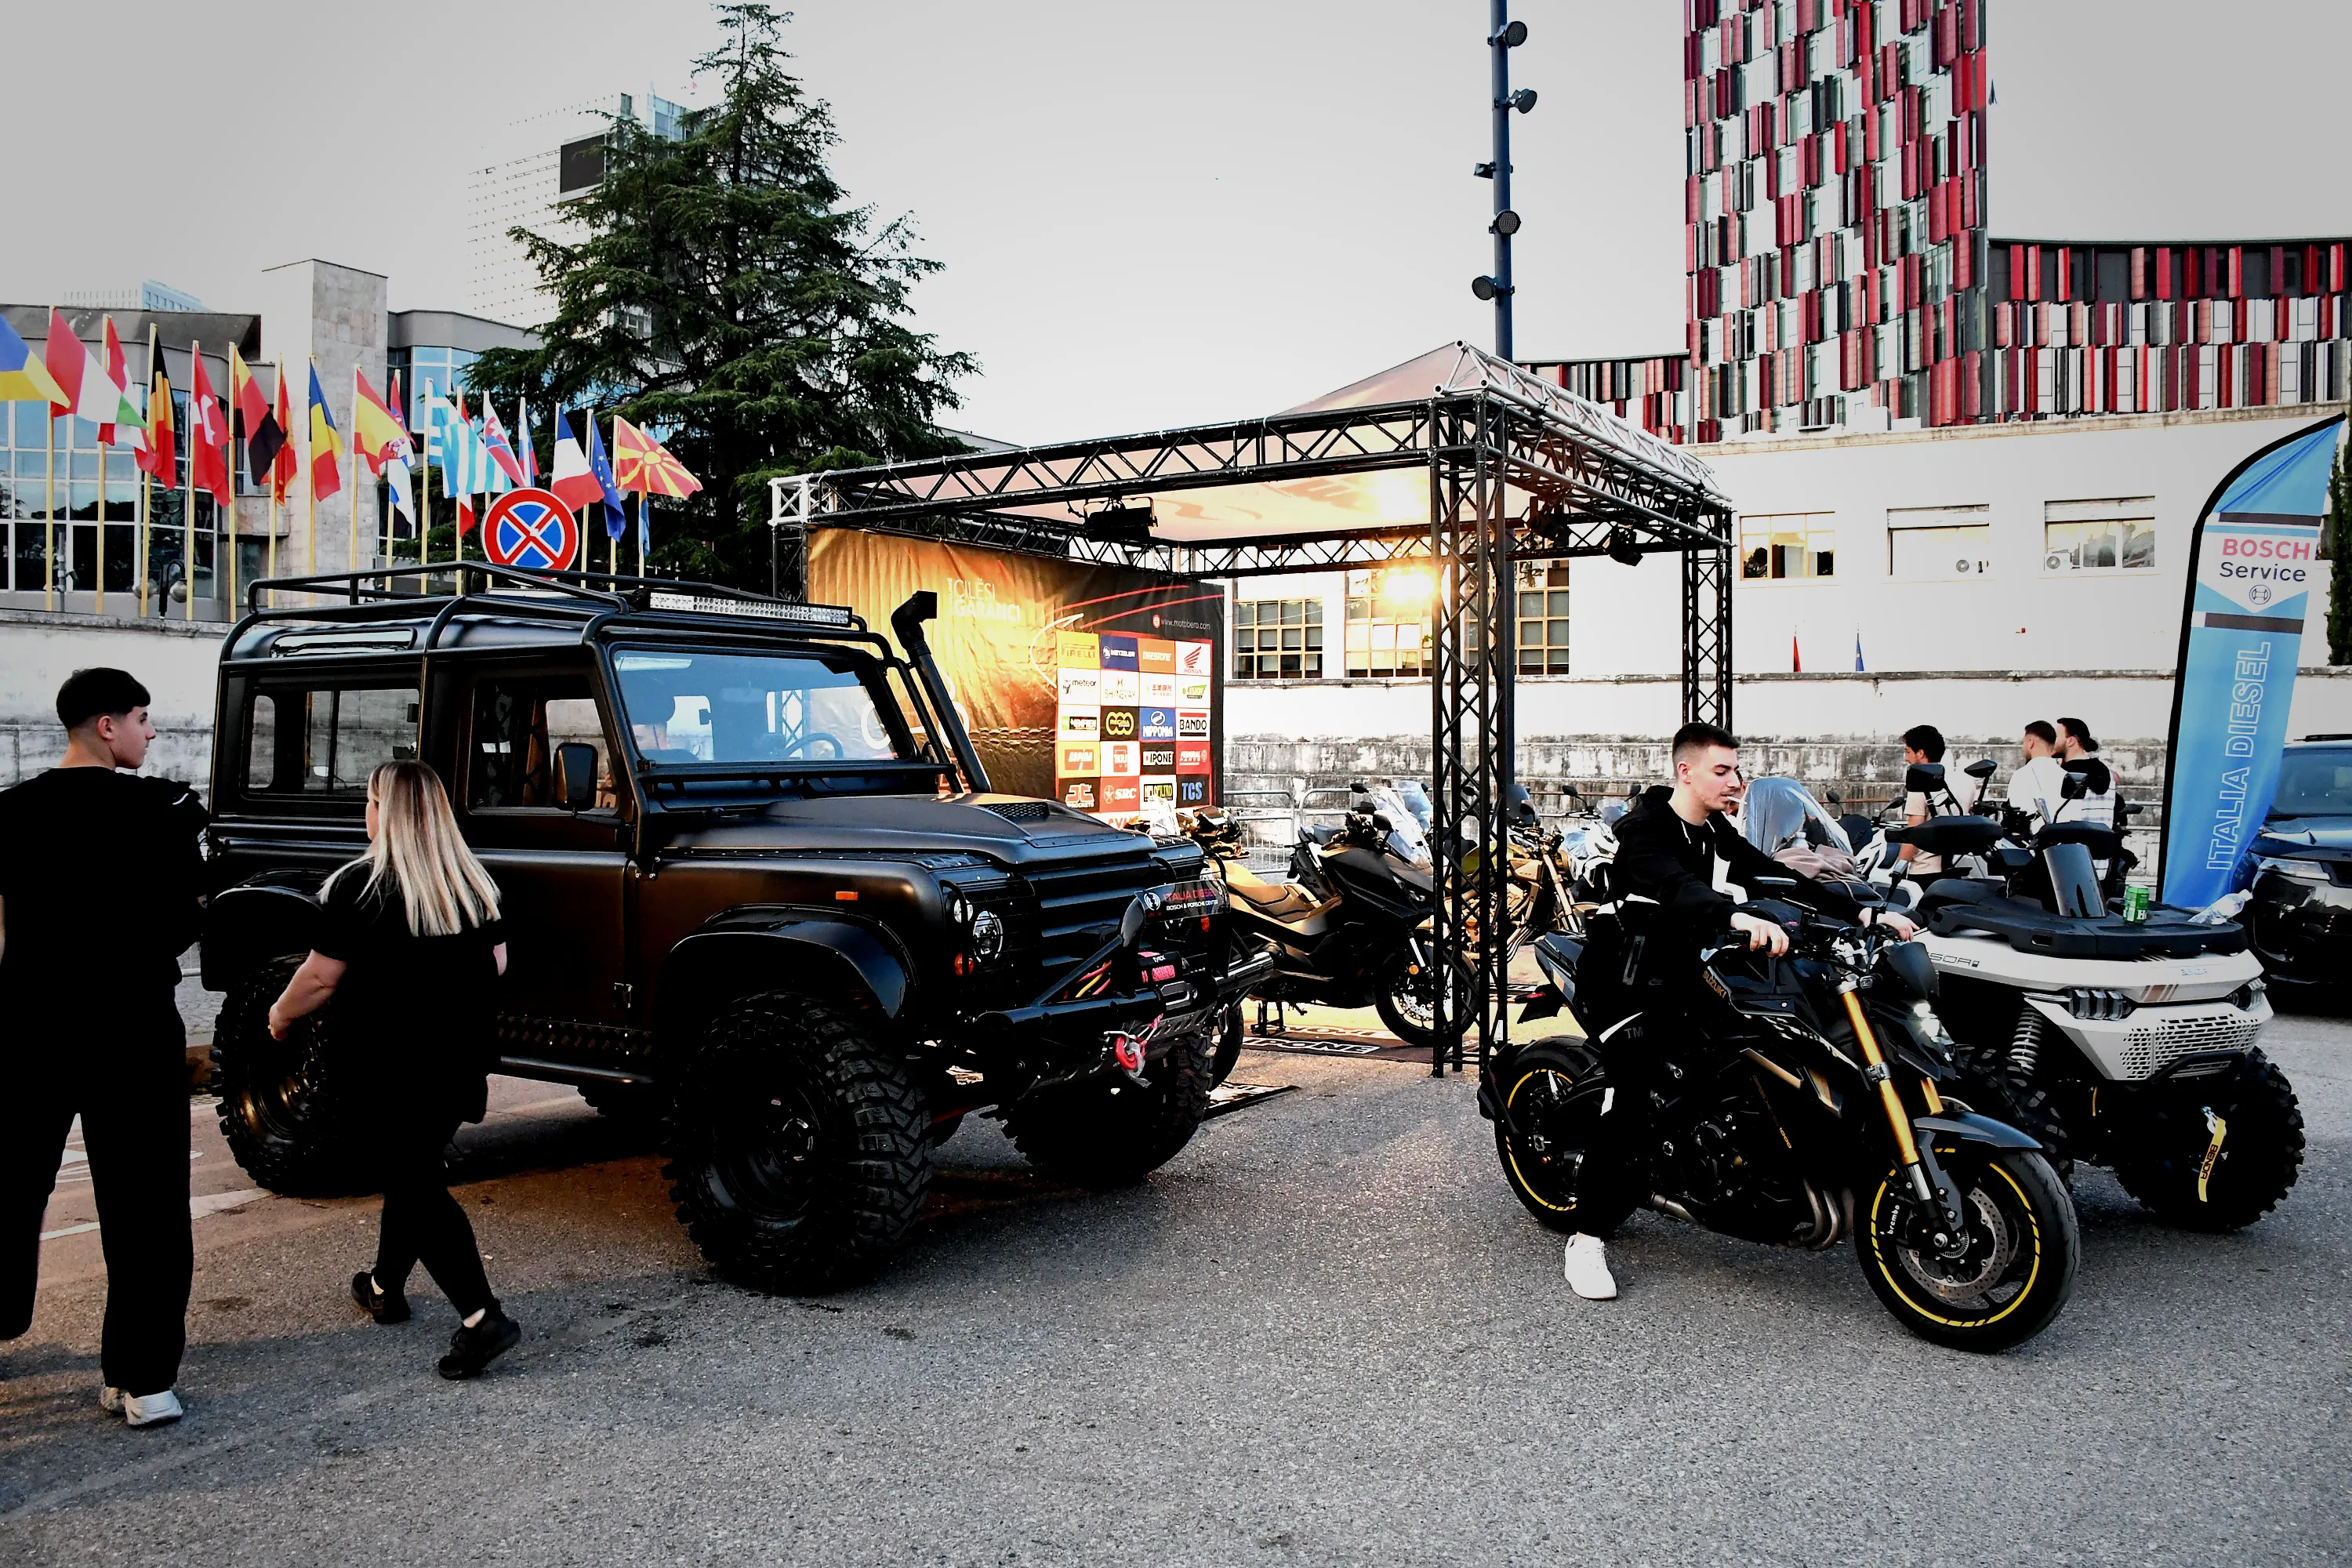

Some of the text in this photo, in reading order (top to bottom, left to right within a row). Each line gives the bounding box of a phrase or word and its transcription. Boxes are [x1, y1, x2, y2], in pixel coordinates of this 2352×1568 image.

[2222, 538, 2310, 561] BOSCH
[2220, 561, 2306, 582] Service
[953, 598, 1020, 622] GARANCI
[1161, 618, 1210, 630] www.motobero.com
[1061, 644, 1095, 659] PIRELLI
[1179, 719, 1207, 731] BANDO
[1149, 753, 1172, 763] IPONE
[2206, 641, 2271, 869] ITALIA DIESEL
[1115, 788, 1137, 800] SRC
[1181, 782, 1203, 800] TCS
[1163, 889, 1192, 902] ITALIA
[1187, 900, 1206, 909] PORSCHE
[1703, 971, 1726, 998] SUZUKI
[1779, 1127, 1792, 1149] 1000
[1887, 1205, 1900, 1235] brembo
